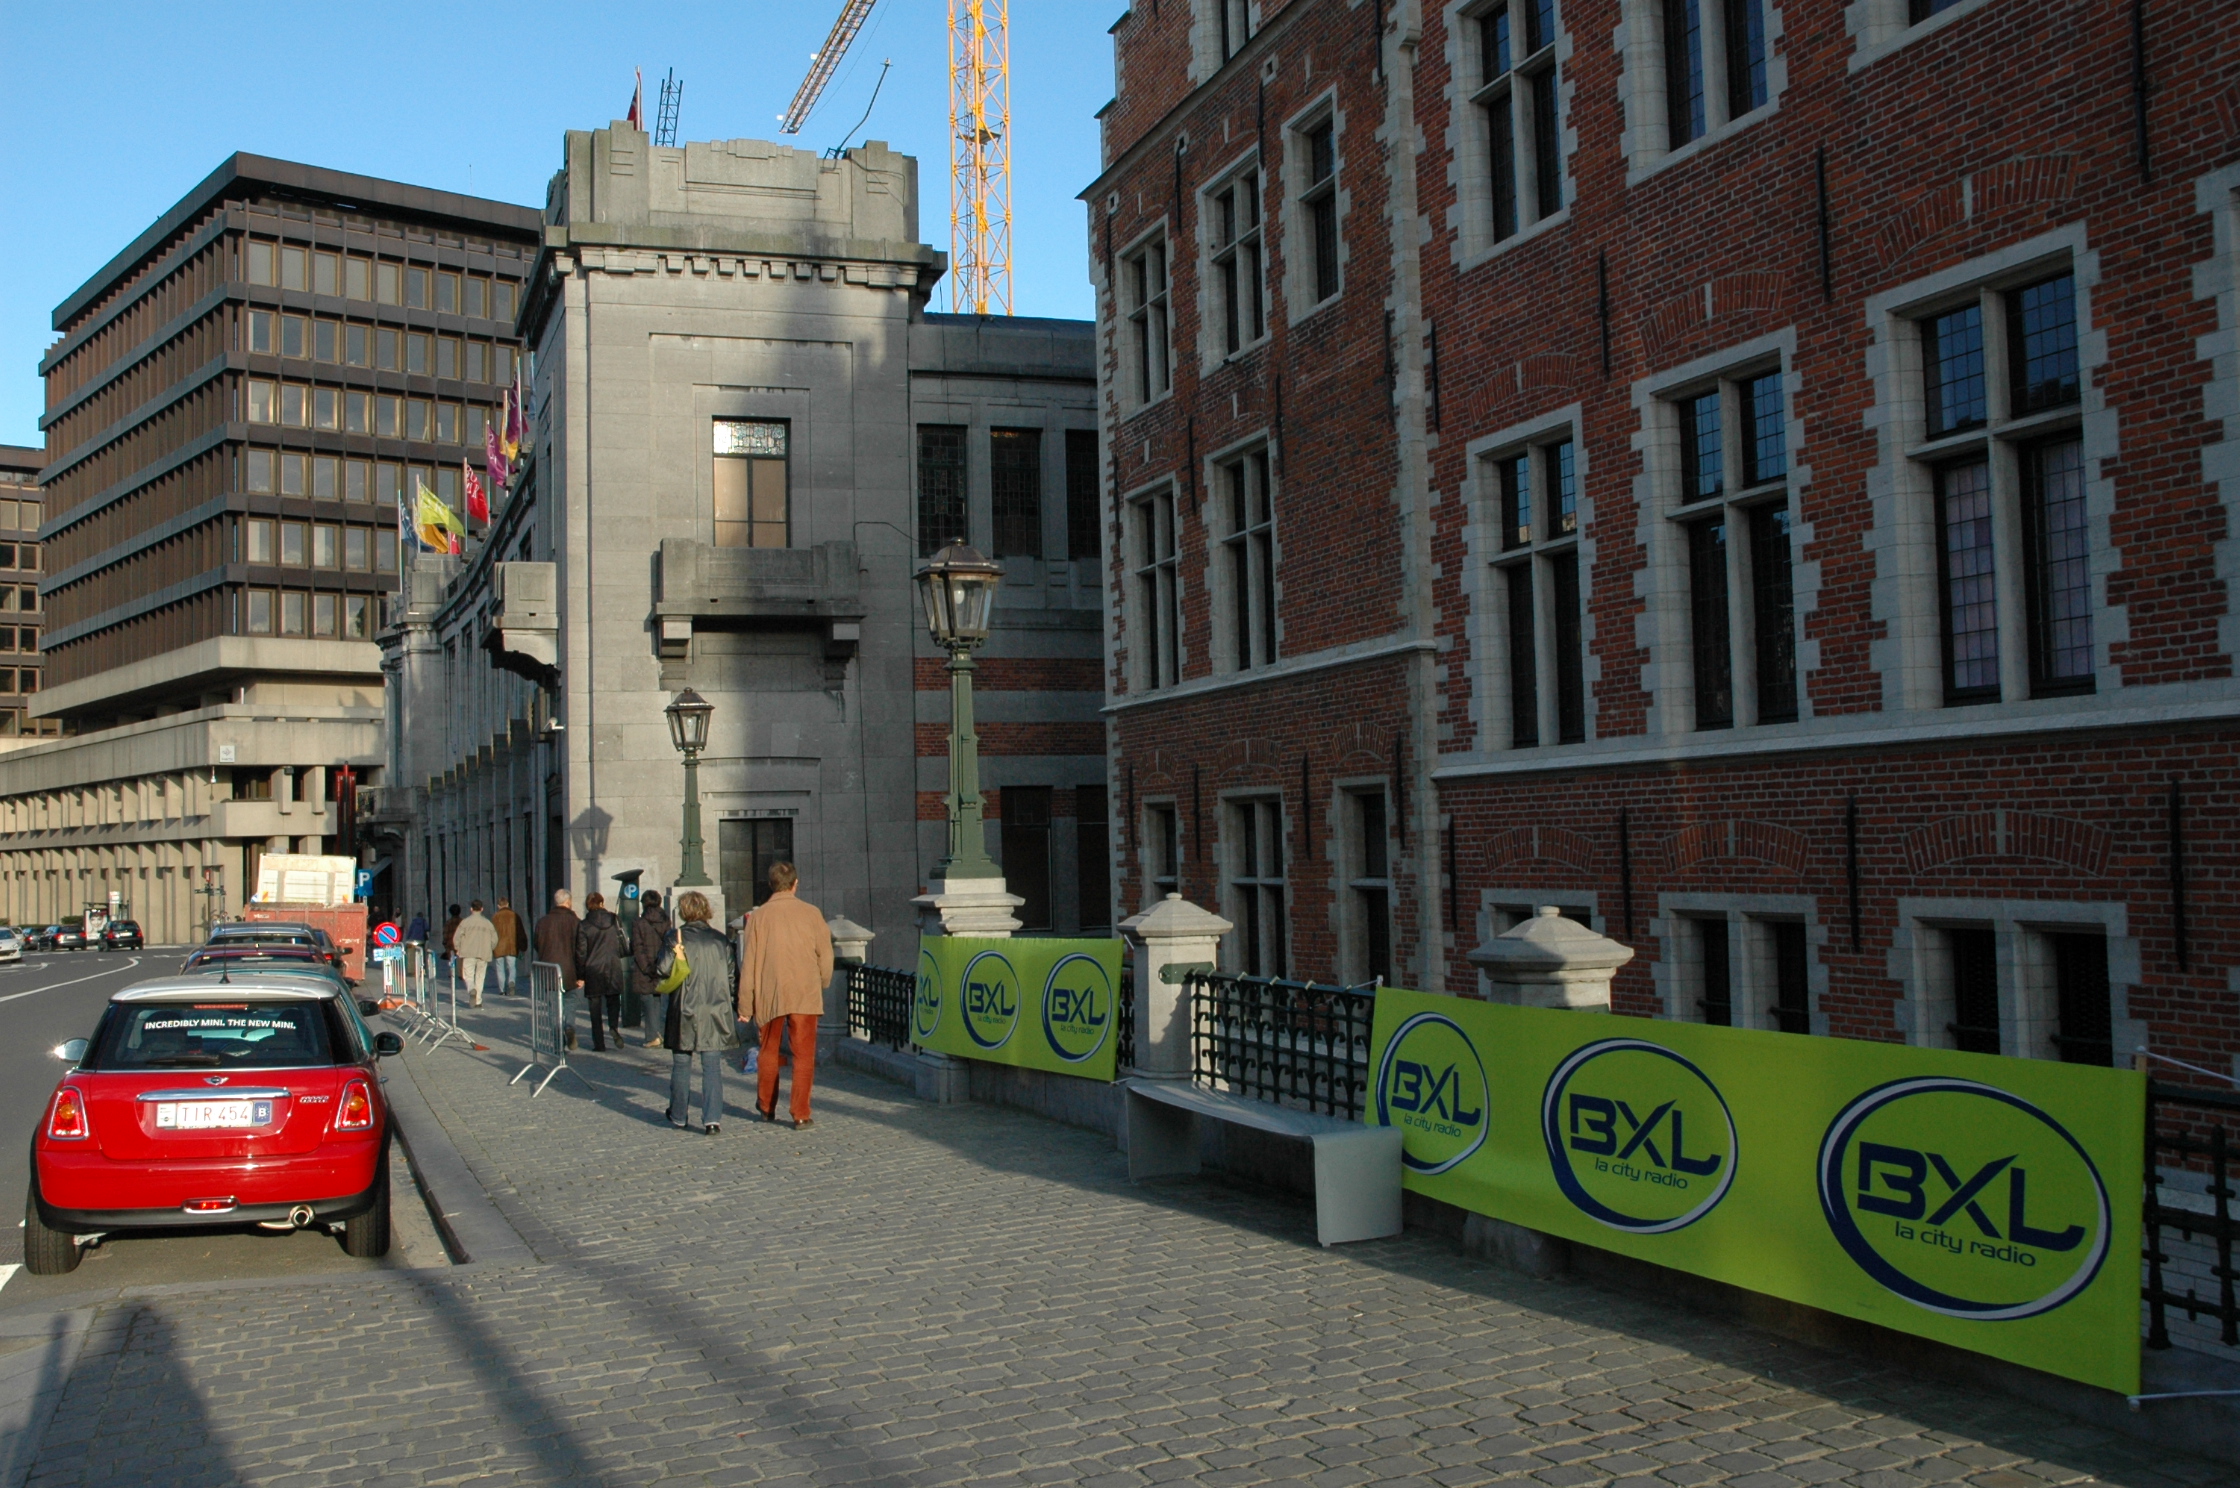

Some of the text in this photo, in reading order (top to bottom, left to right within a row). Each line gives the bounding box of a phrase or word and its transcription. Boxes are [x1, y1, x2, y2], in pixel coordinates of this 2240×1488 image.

[360, 872, 370, 887] P
[969, 980, 1015, 1016] BXL
[1052, 985, 1106, 1025] BXL
[144, 1019, 297, 1029] INCREDIBLY MINI. THE NEW MINI.
[1067, 1024, 1078, 1034] city
[1078, 1026, 1094, 1035] radio
[1391, 1059, 1482, 1126] BXL
[182, 1107, 211, 1121] TIR
[218, 1106, 249, 1120] 454
[258, 1108, 266, 1117] B
[1403, 1113, 1462, 1137] la city radio
[1569, 1093, 1722, 1176] BXL
[1595, 1157, 1689, 1189] la city radio
[1857, 1141, 2086, 1251] BXL
[1895, 1221, 2037, 1267] la city radio
